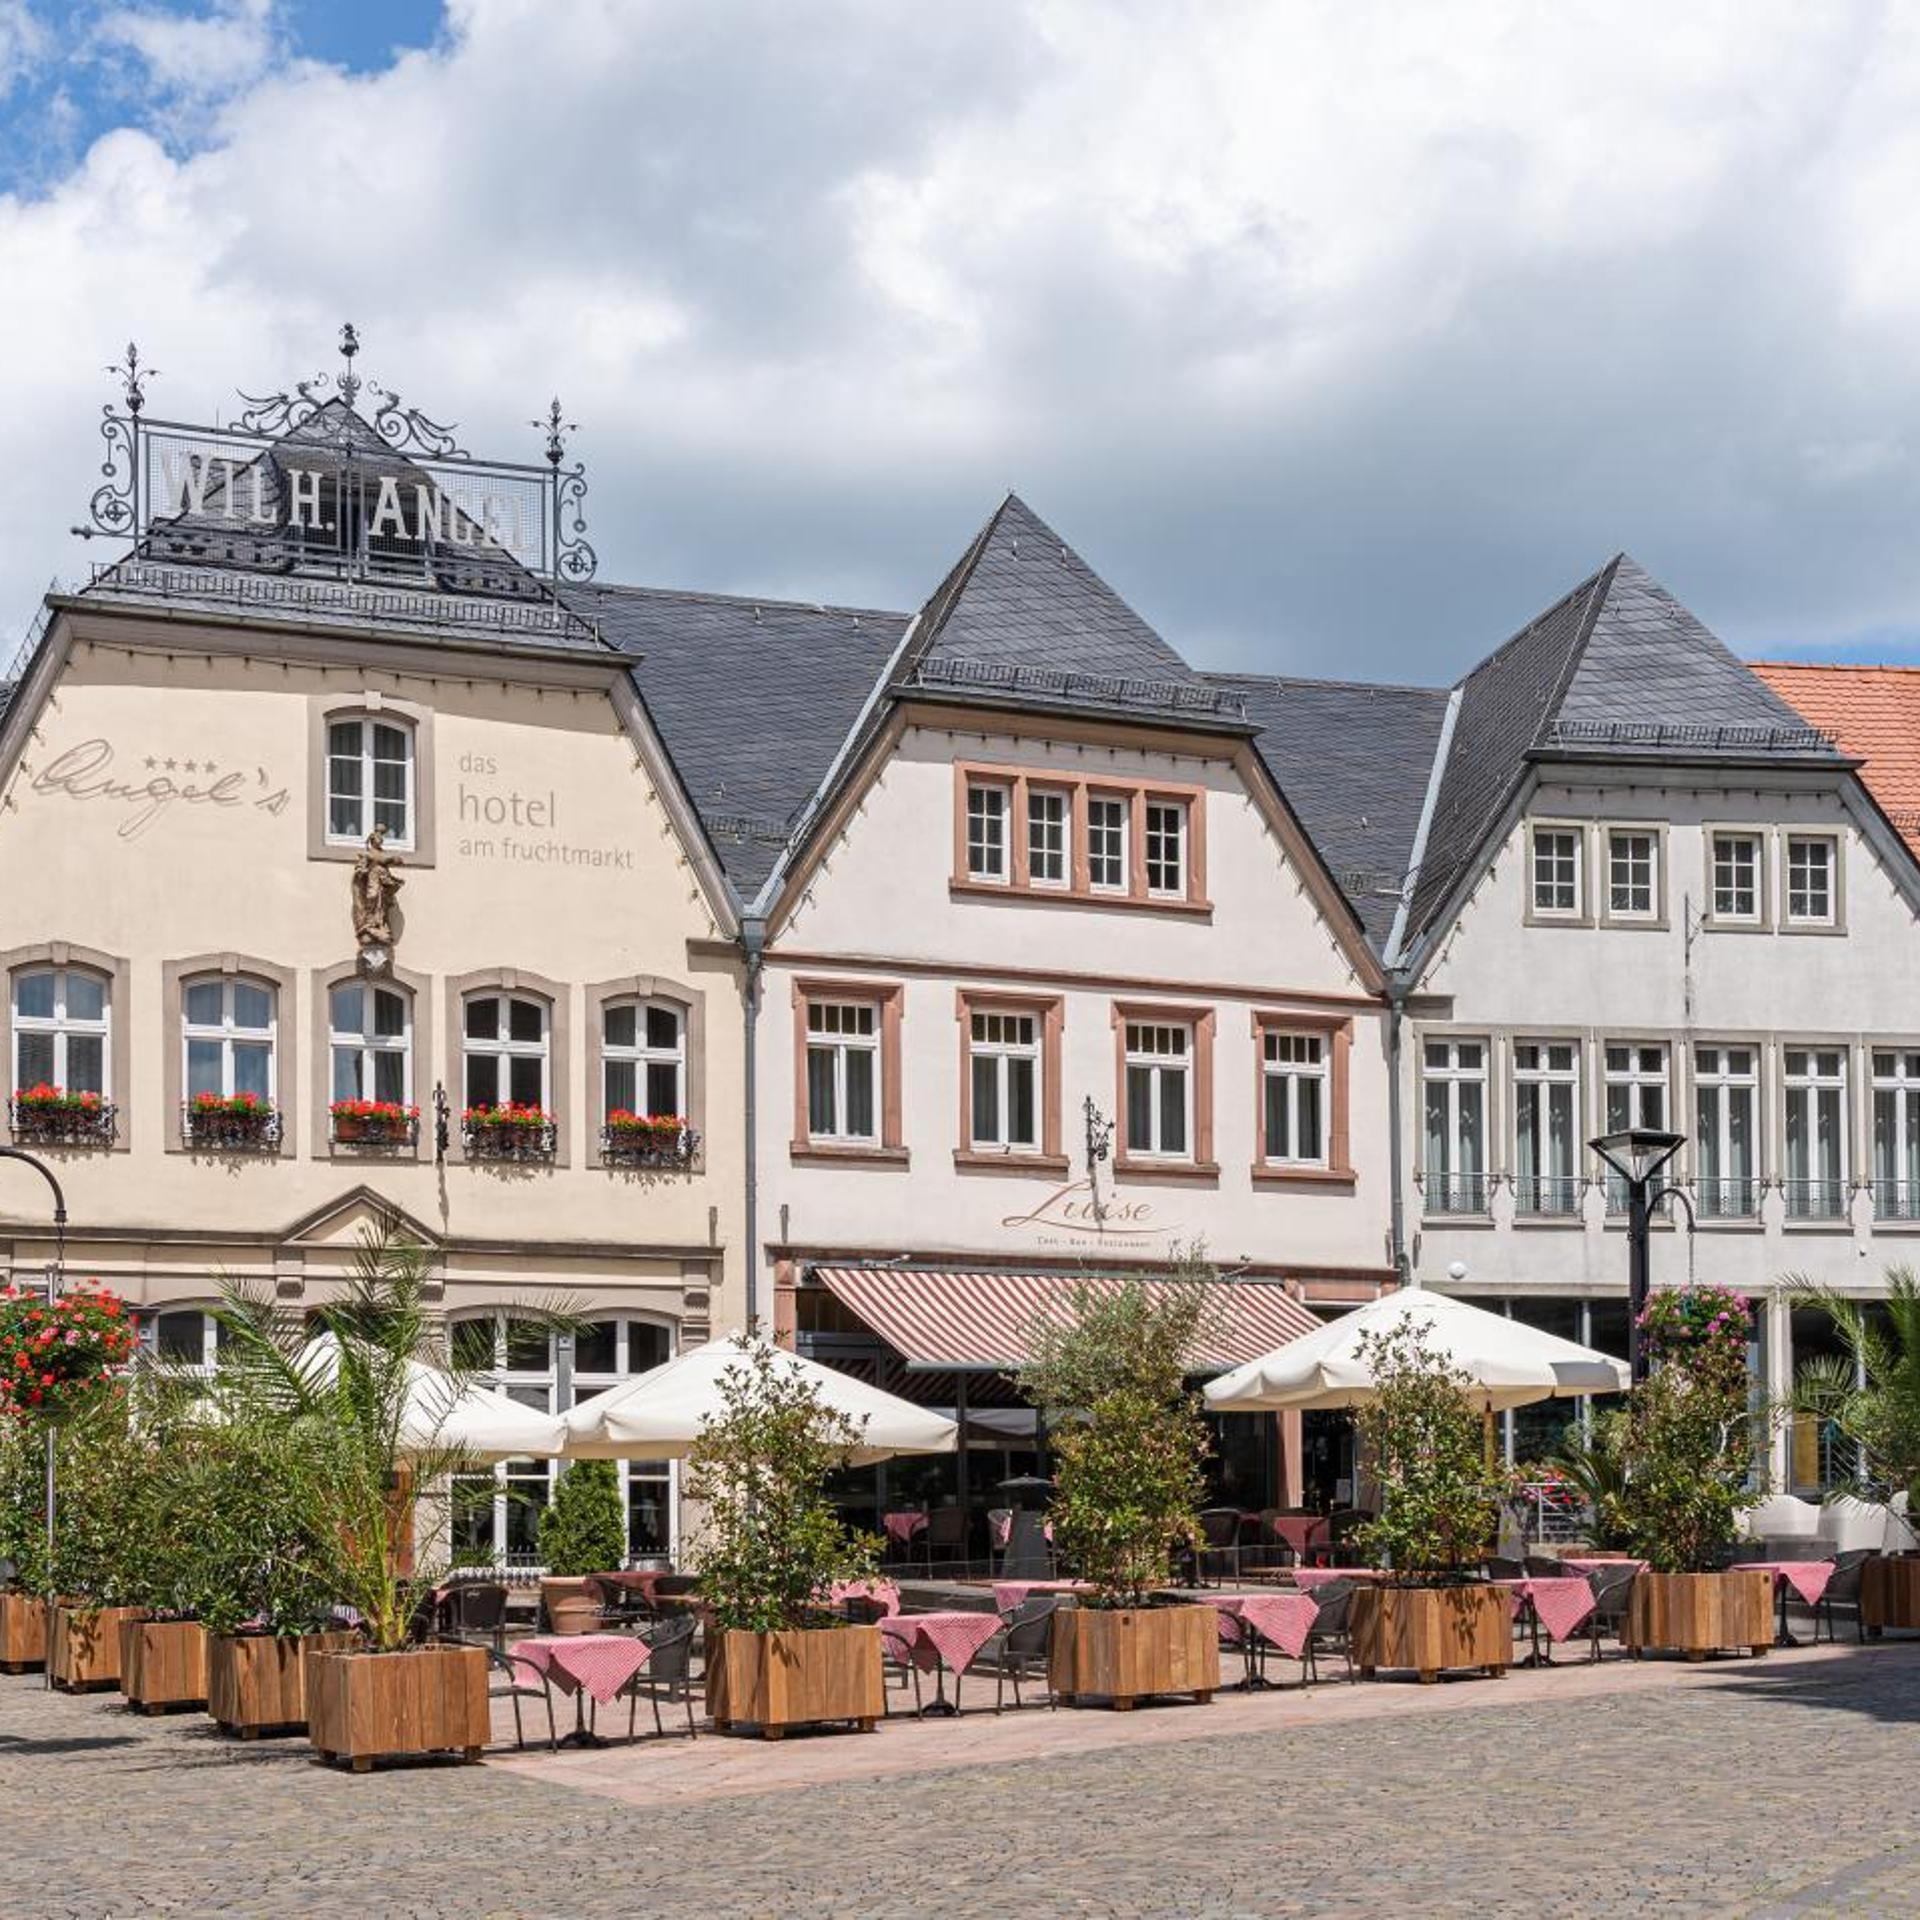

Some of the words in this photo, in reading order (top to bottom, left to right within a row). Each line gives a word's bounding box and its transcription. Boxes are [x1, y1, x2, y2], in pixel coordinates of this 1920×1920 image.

[460, 753, 497, 774] das
[458, 784, 555, 828] hotel
[459, 838, 495, 858] am
[503, 836, 634, 869] fruchtmarkt
